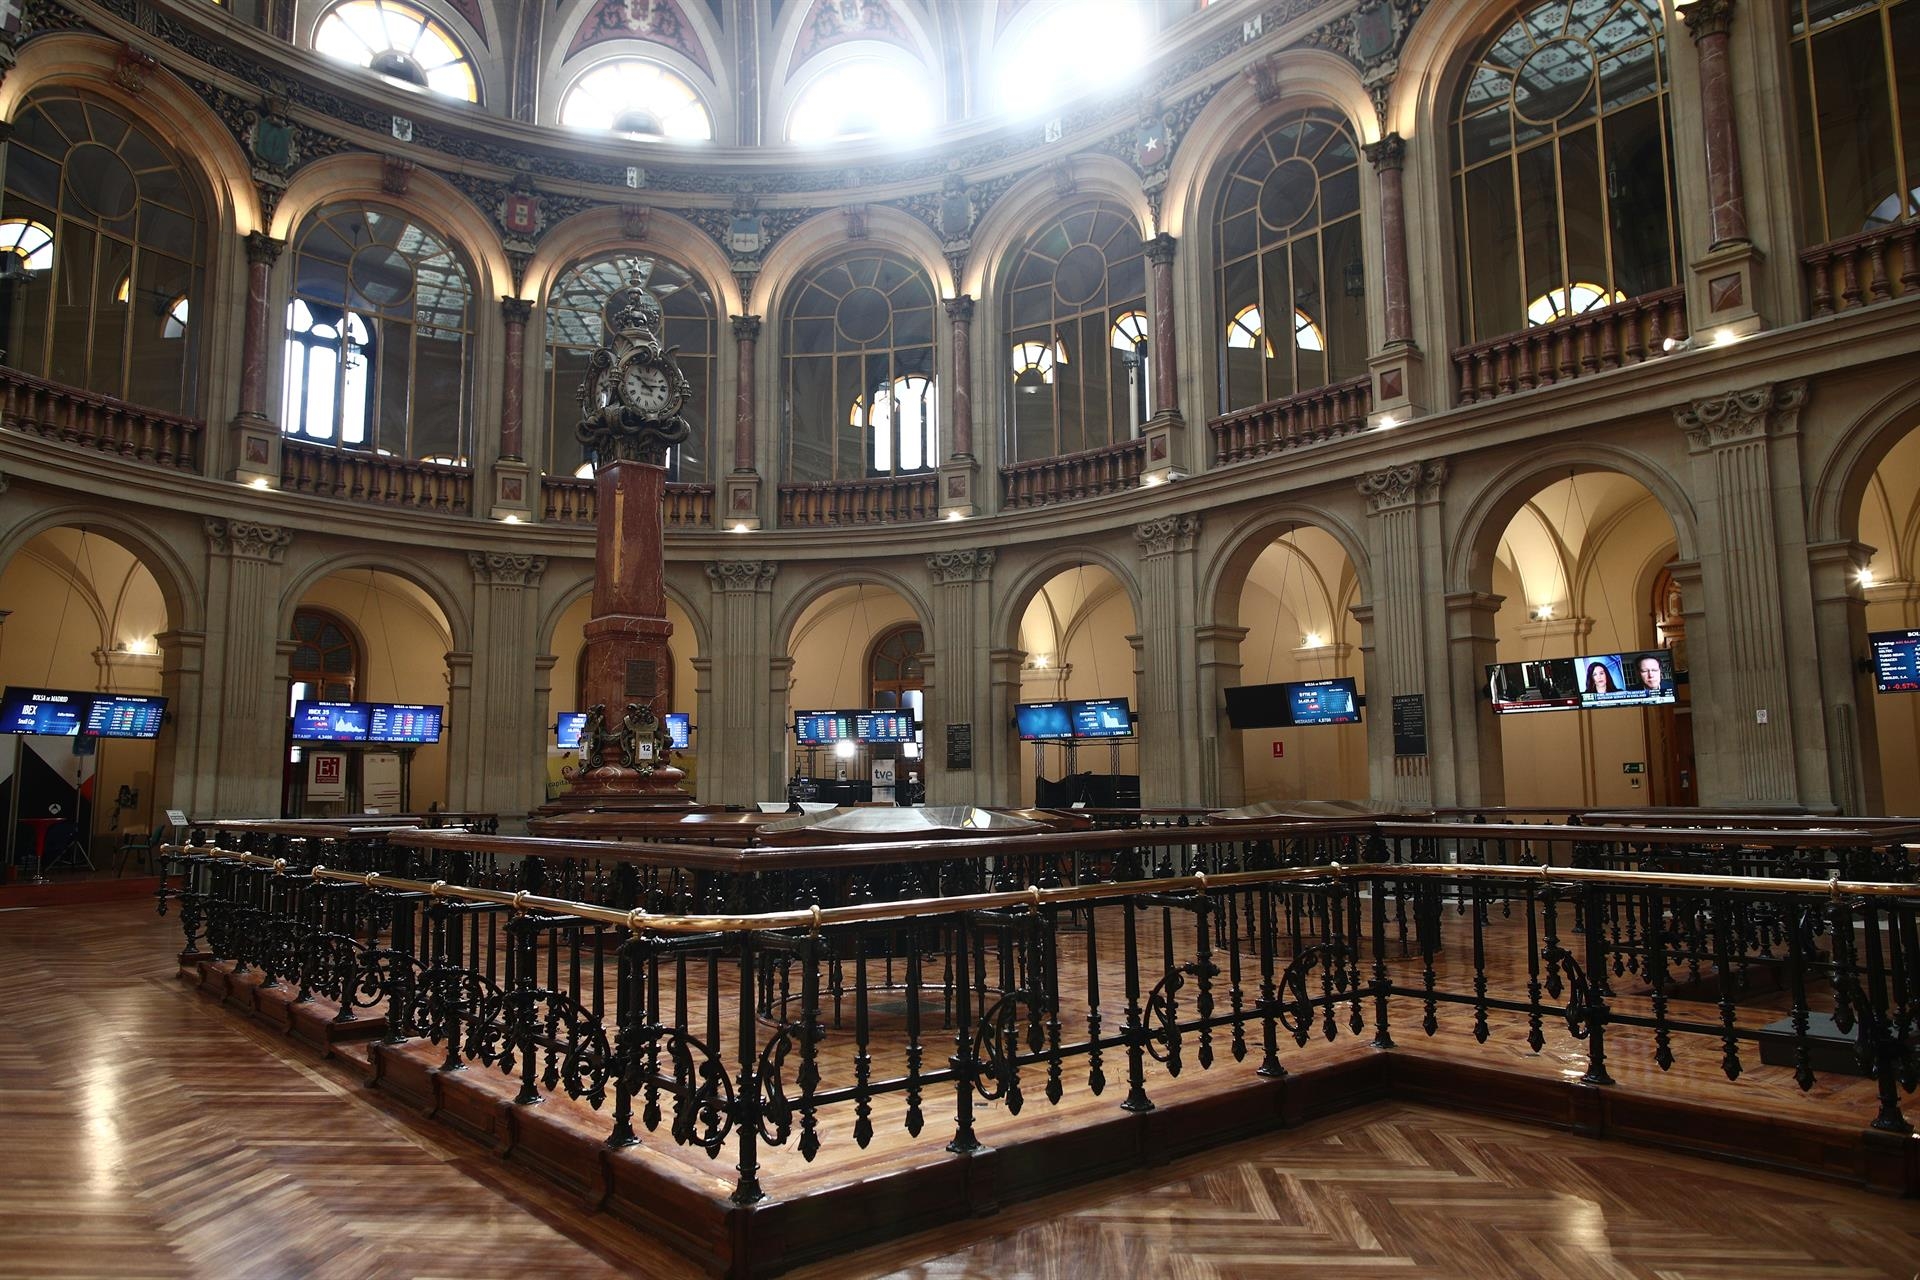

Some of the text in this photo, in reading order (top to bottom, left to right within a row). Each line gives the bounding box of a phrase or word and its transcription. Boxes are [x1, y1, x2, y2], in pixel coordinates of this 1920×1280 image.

[22, 705, 38, 715] IBEX
[317, 758, 339, 777] Ei
[874, 768, 893, 780] tve
